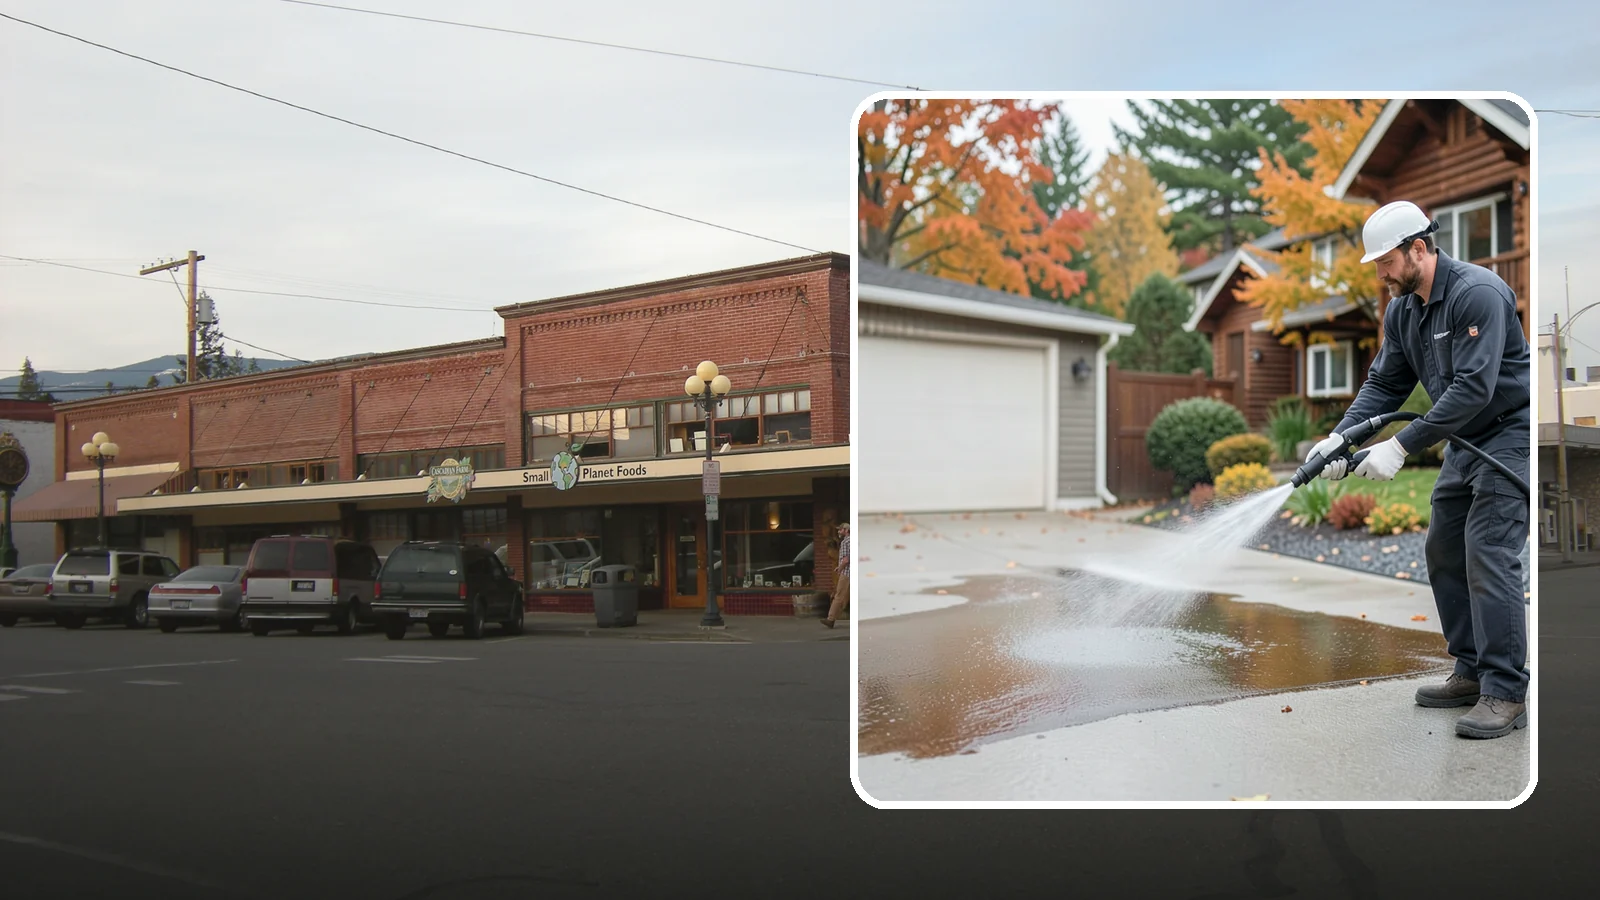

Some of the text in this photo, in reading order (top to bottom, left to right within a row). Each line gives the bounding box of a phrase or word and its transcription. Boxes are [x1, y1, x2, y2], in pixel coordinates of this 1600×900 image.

[523, 464, 646, 482] Small Planet Foods
